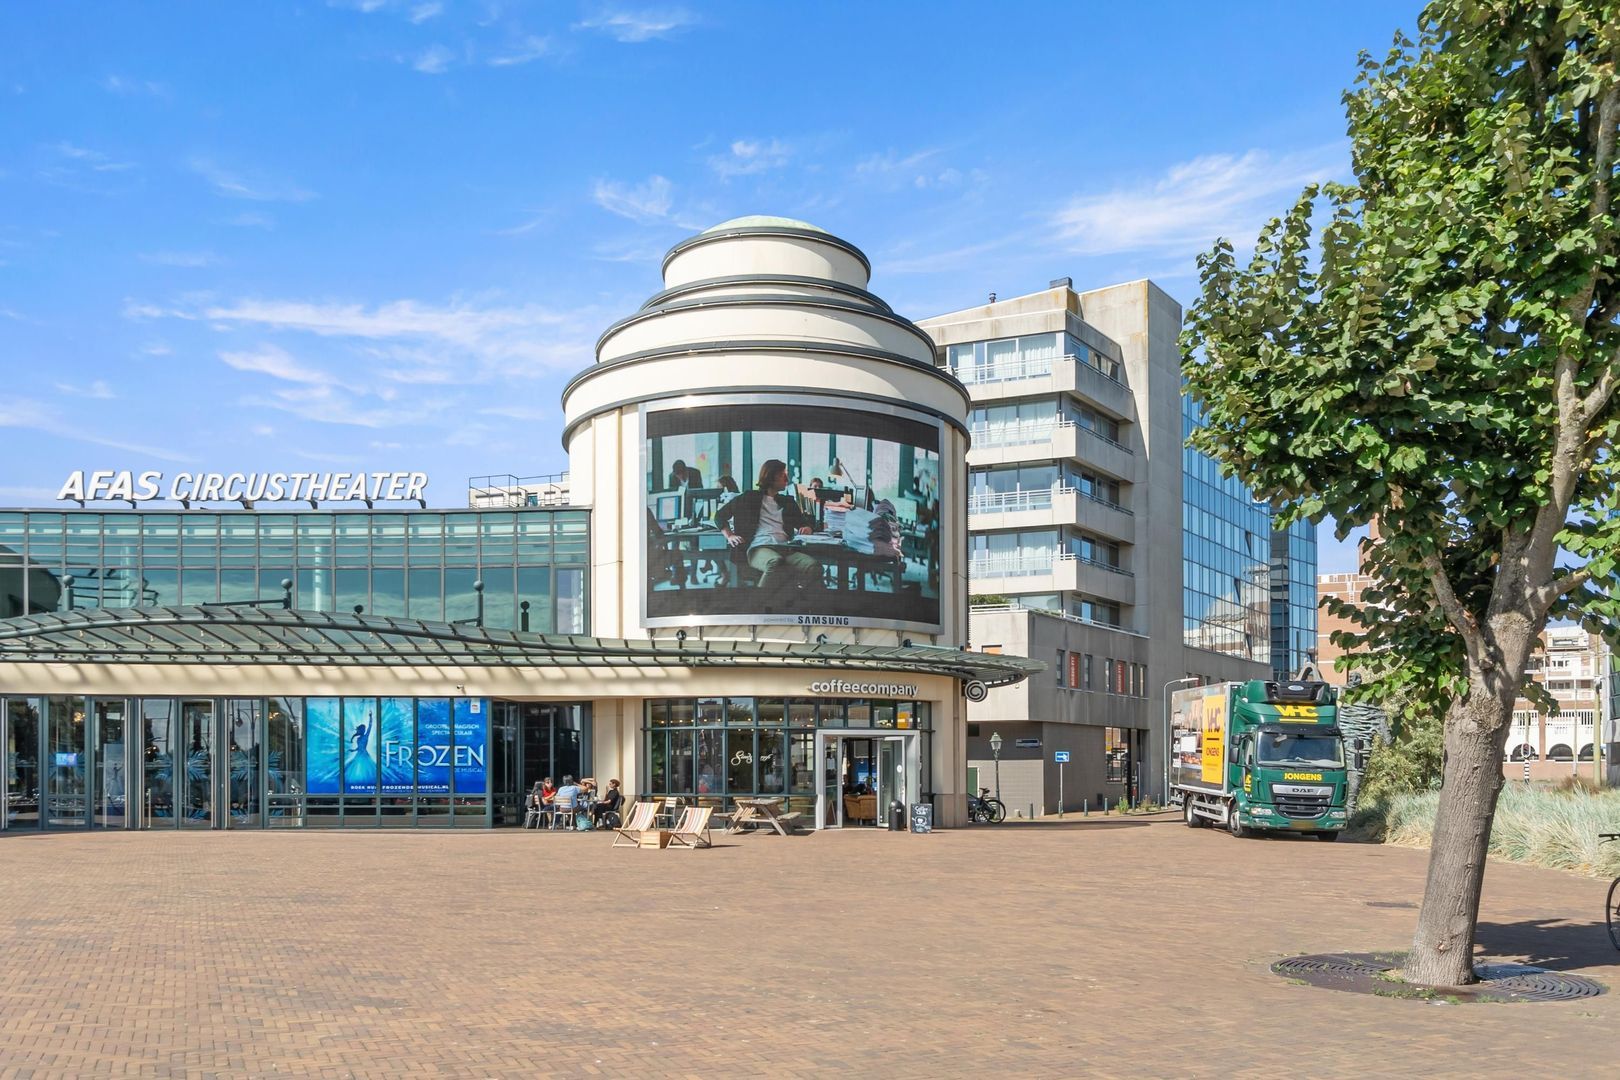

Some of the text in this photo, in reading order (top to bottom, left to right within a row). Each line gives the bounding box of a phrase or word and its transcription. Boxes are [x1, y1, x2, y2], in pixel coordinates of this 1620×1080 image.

[57, 470, 428, 501] AFAS CIRCUSTHEATER
[798, 616, 849, 625] SAMSUNG
[811, 679, 918, 697] coffeecompany
[1274, 704, 1319, 717] VHC
[385, 740, 484, 768] FROZEN
[1284, 773, 1322, 781] JONGENS
